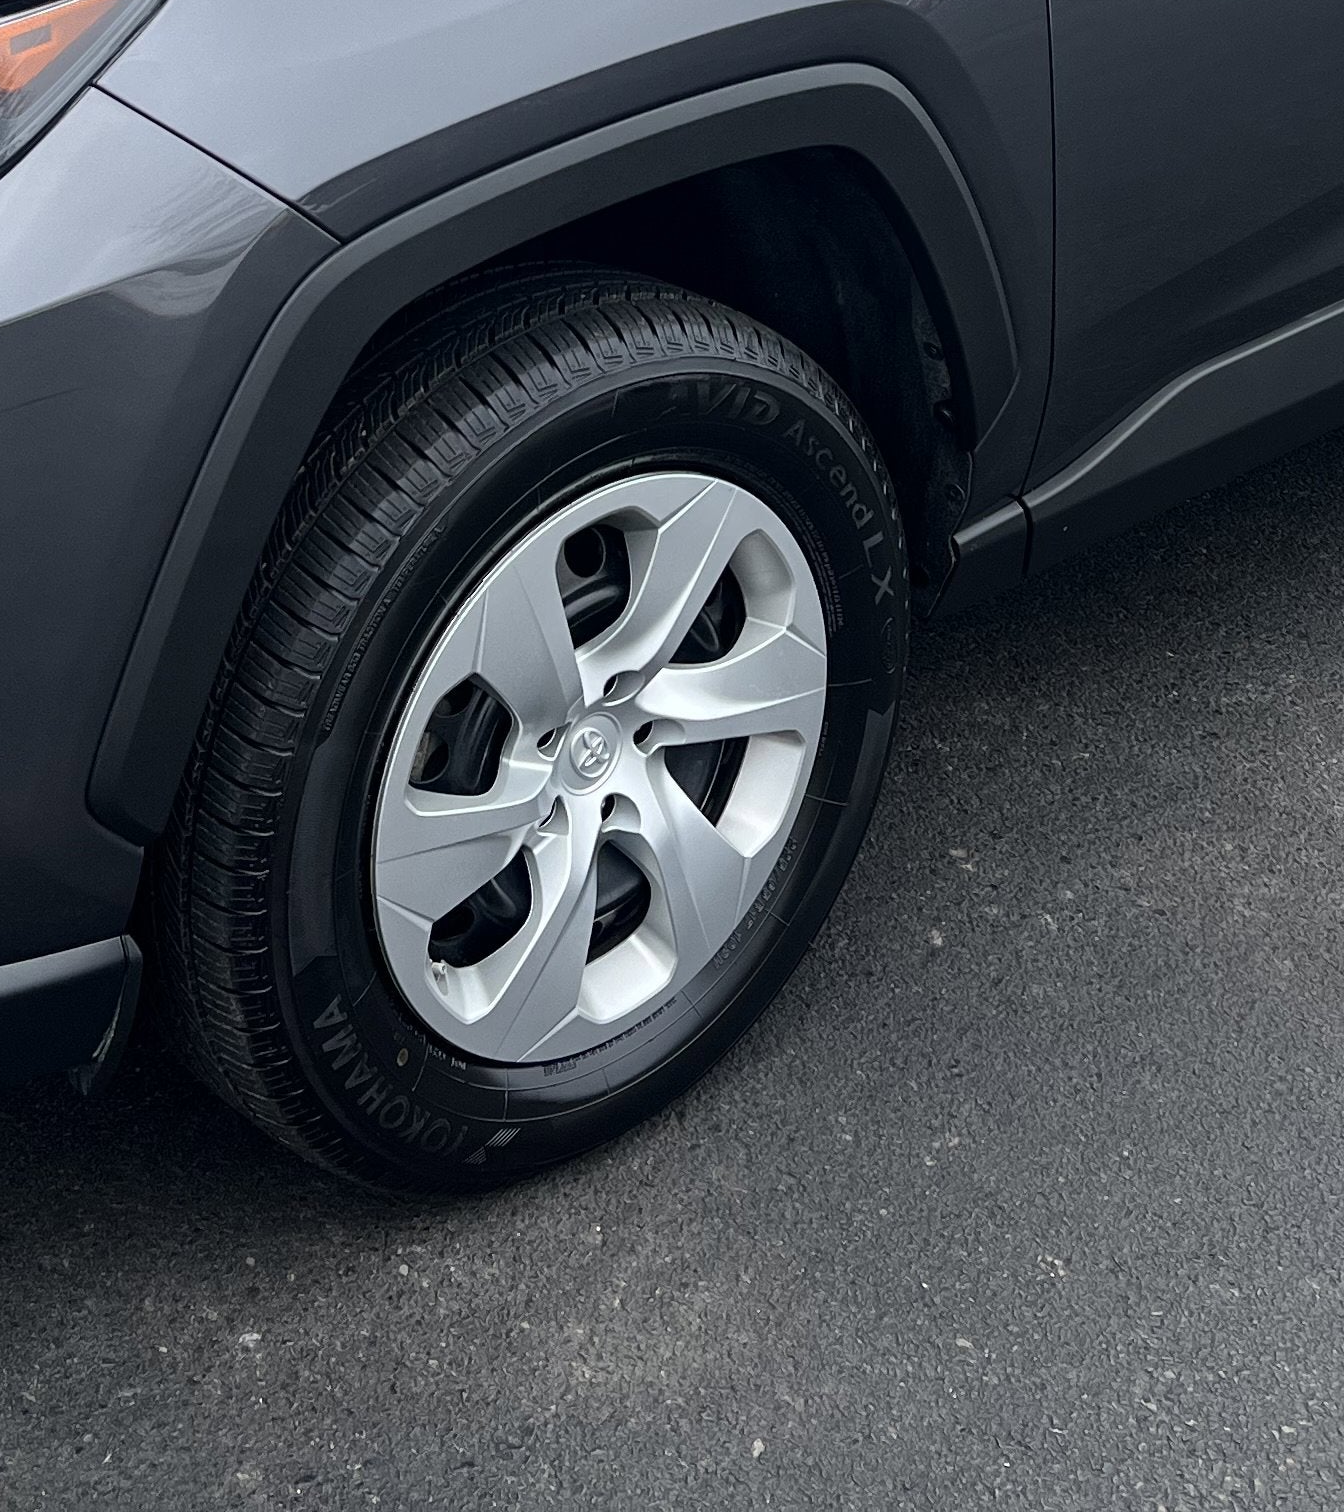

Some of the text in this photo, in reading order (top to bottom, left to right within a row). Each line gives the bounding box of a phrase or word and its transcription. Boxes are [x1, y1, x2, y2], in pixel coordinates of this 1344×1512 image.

[781, 418, 876, 531] Ascend
[862, 530, 895, 607] LX
[312, 993, 468, 1156] YOKOHAMA
